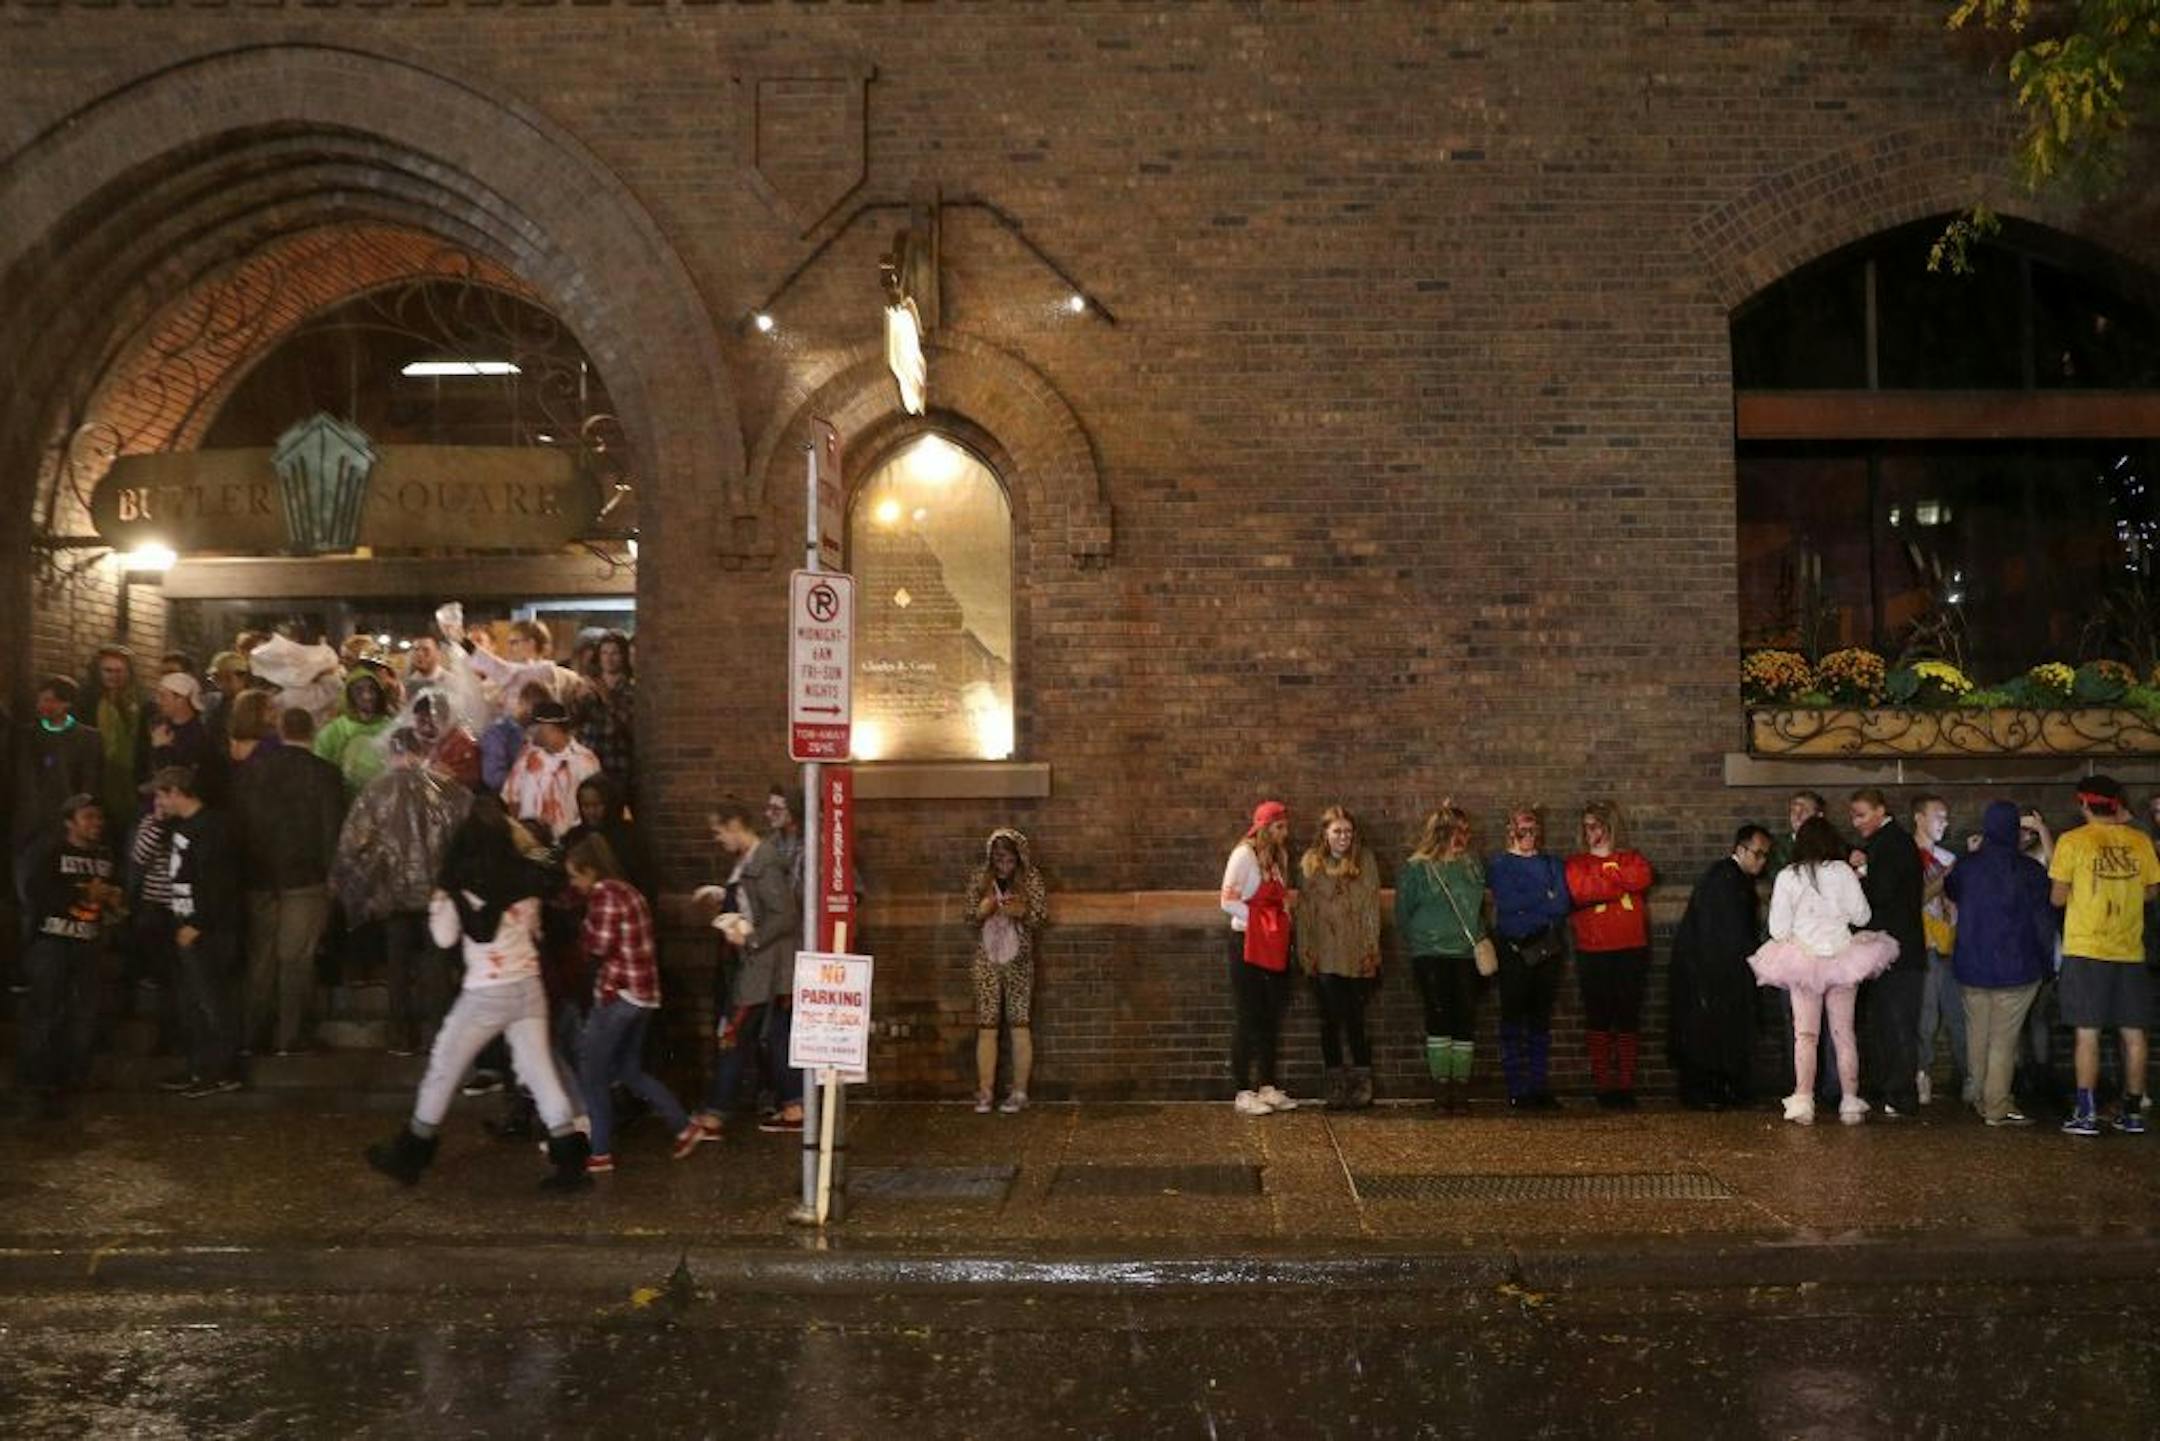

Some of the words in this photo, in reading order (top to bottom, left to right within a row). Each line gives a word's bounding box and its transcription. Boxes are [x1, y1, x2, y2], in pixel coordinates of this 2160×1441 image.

[375, 480, 561, 515] SQUARE
[805, 683, 840, 699] NIGHTS
[821, 963, 845, 985] NO
[801, 988, 862, 1007] PARKING
